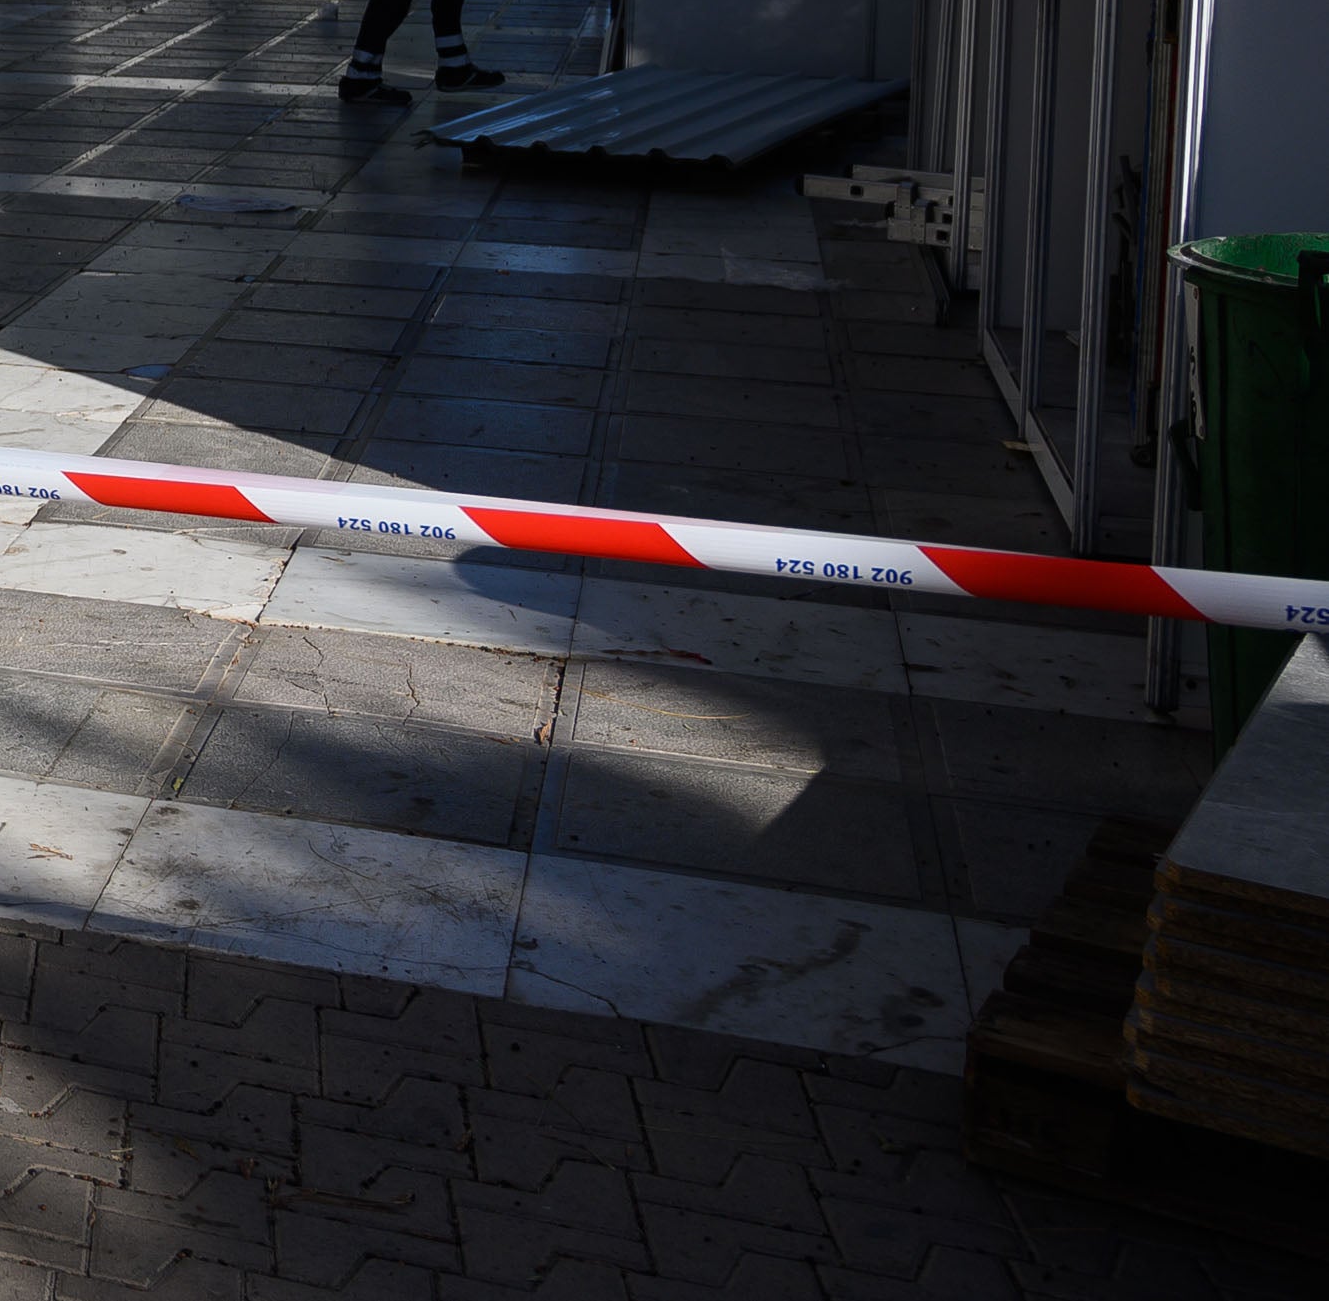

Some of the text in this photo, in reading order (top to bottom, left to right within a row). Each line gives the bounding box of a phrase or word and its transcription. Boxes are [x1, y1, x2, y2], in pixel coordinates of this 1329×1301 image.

[28, 487, 61, 500] 902
[337, 516, 456, 540] 902 180 524
[776, 558, 913, 585] 902 180 524
[1285, 604, 1329, 625] 524
